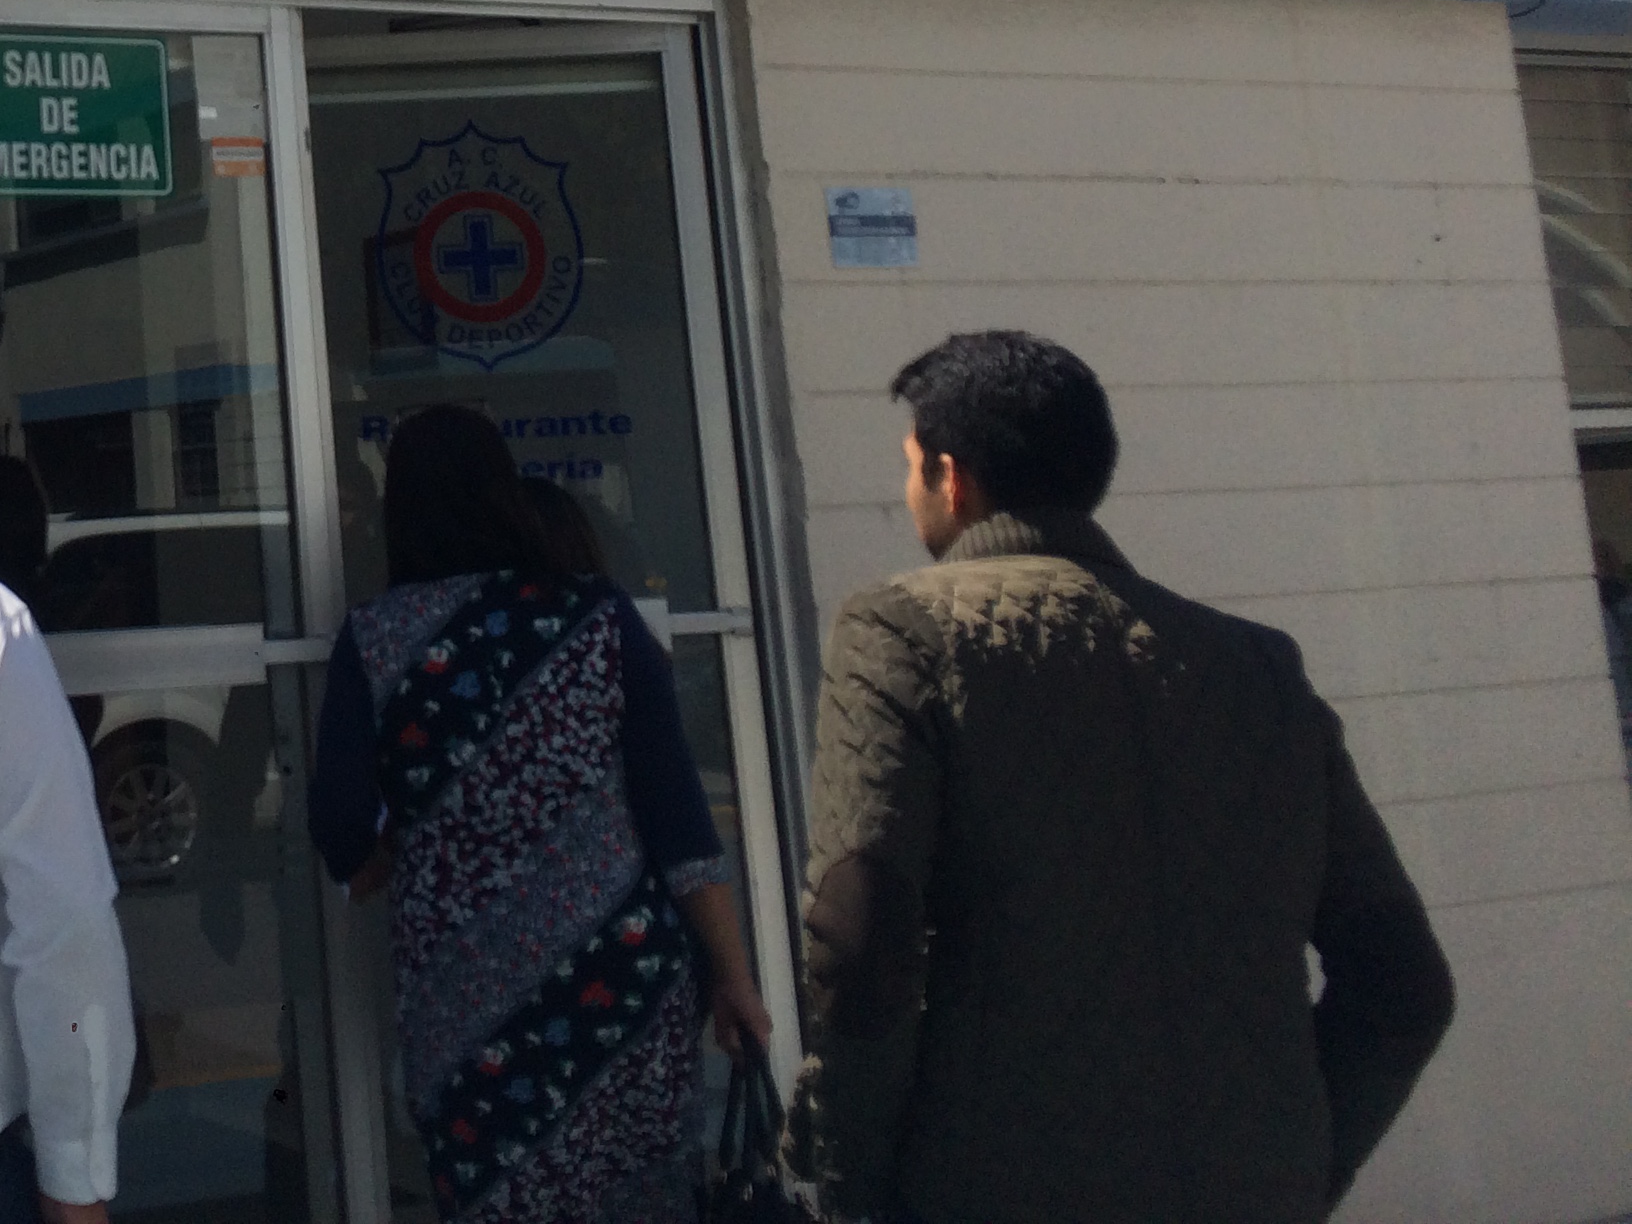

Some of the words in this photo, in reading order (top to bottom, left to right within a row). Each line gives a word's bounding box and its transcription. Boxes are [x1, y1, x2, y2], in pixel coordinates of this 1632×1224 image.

[3, 49, 111, 90] SALIDA
[39, 96, 80, 135] DE
[402, 171, 469, 223] CRUZ
[484, 170, 547, 220] AZUL
[447, 255, 572, 350] DEPORTIVO
